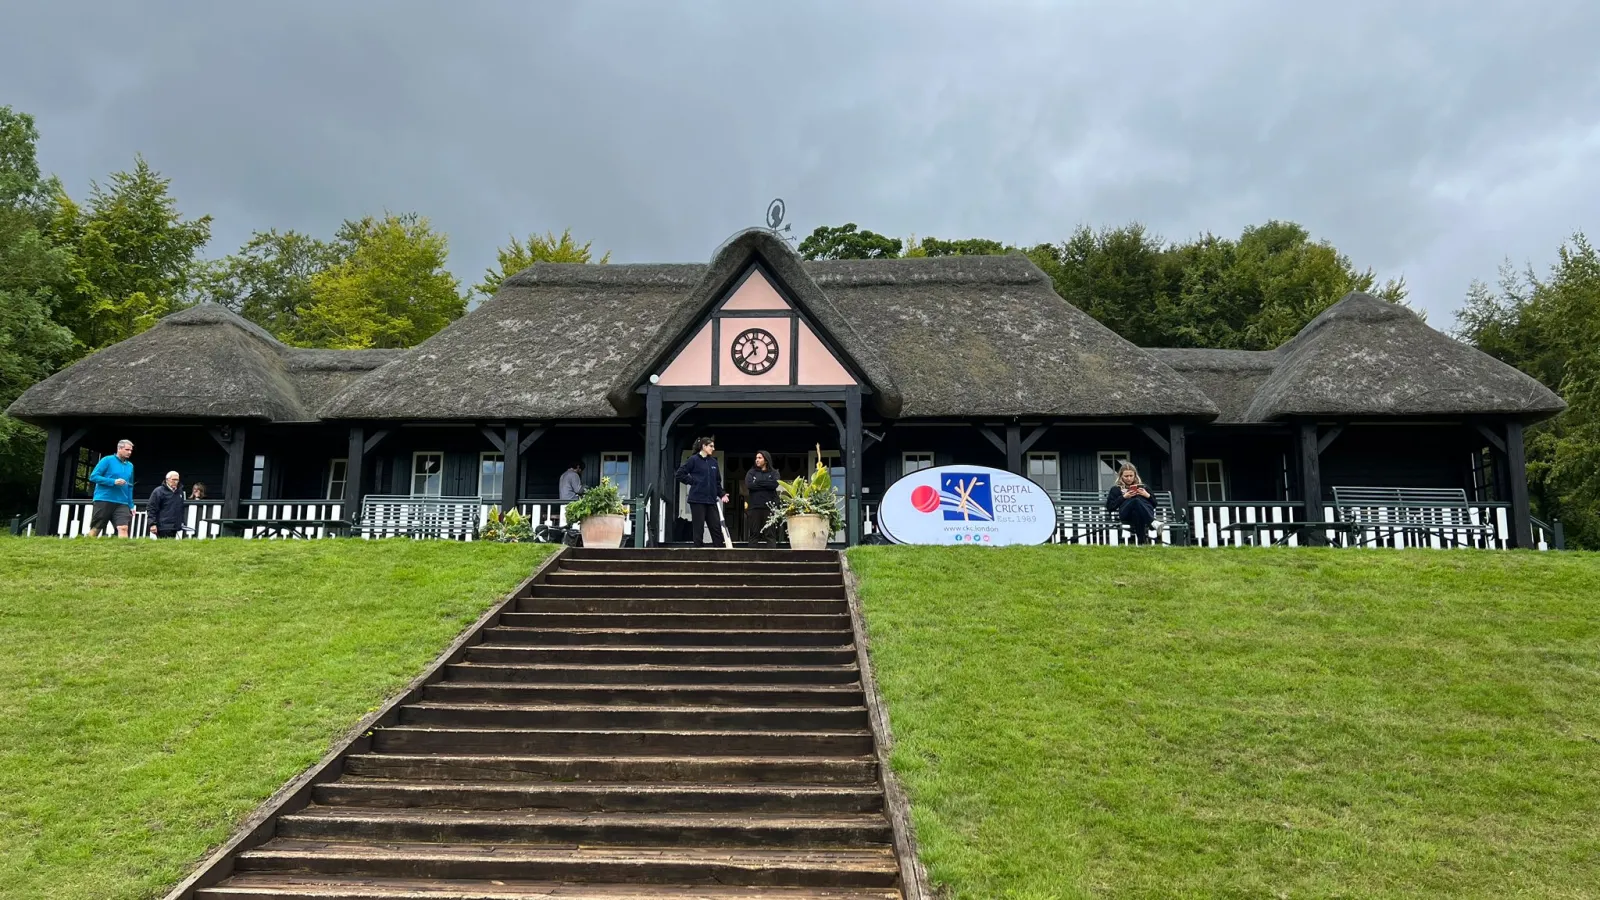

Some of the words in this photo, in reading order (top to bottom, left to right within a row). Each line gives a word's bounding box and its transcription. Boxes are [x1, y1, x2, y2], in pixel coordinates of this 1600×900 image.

[993, 484, 1032, 494] CAPITAL
[994, 494, 1016, 504] KIDS
[995, 504, 1034, 513] CRICKET
